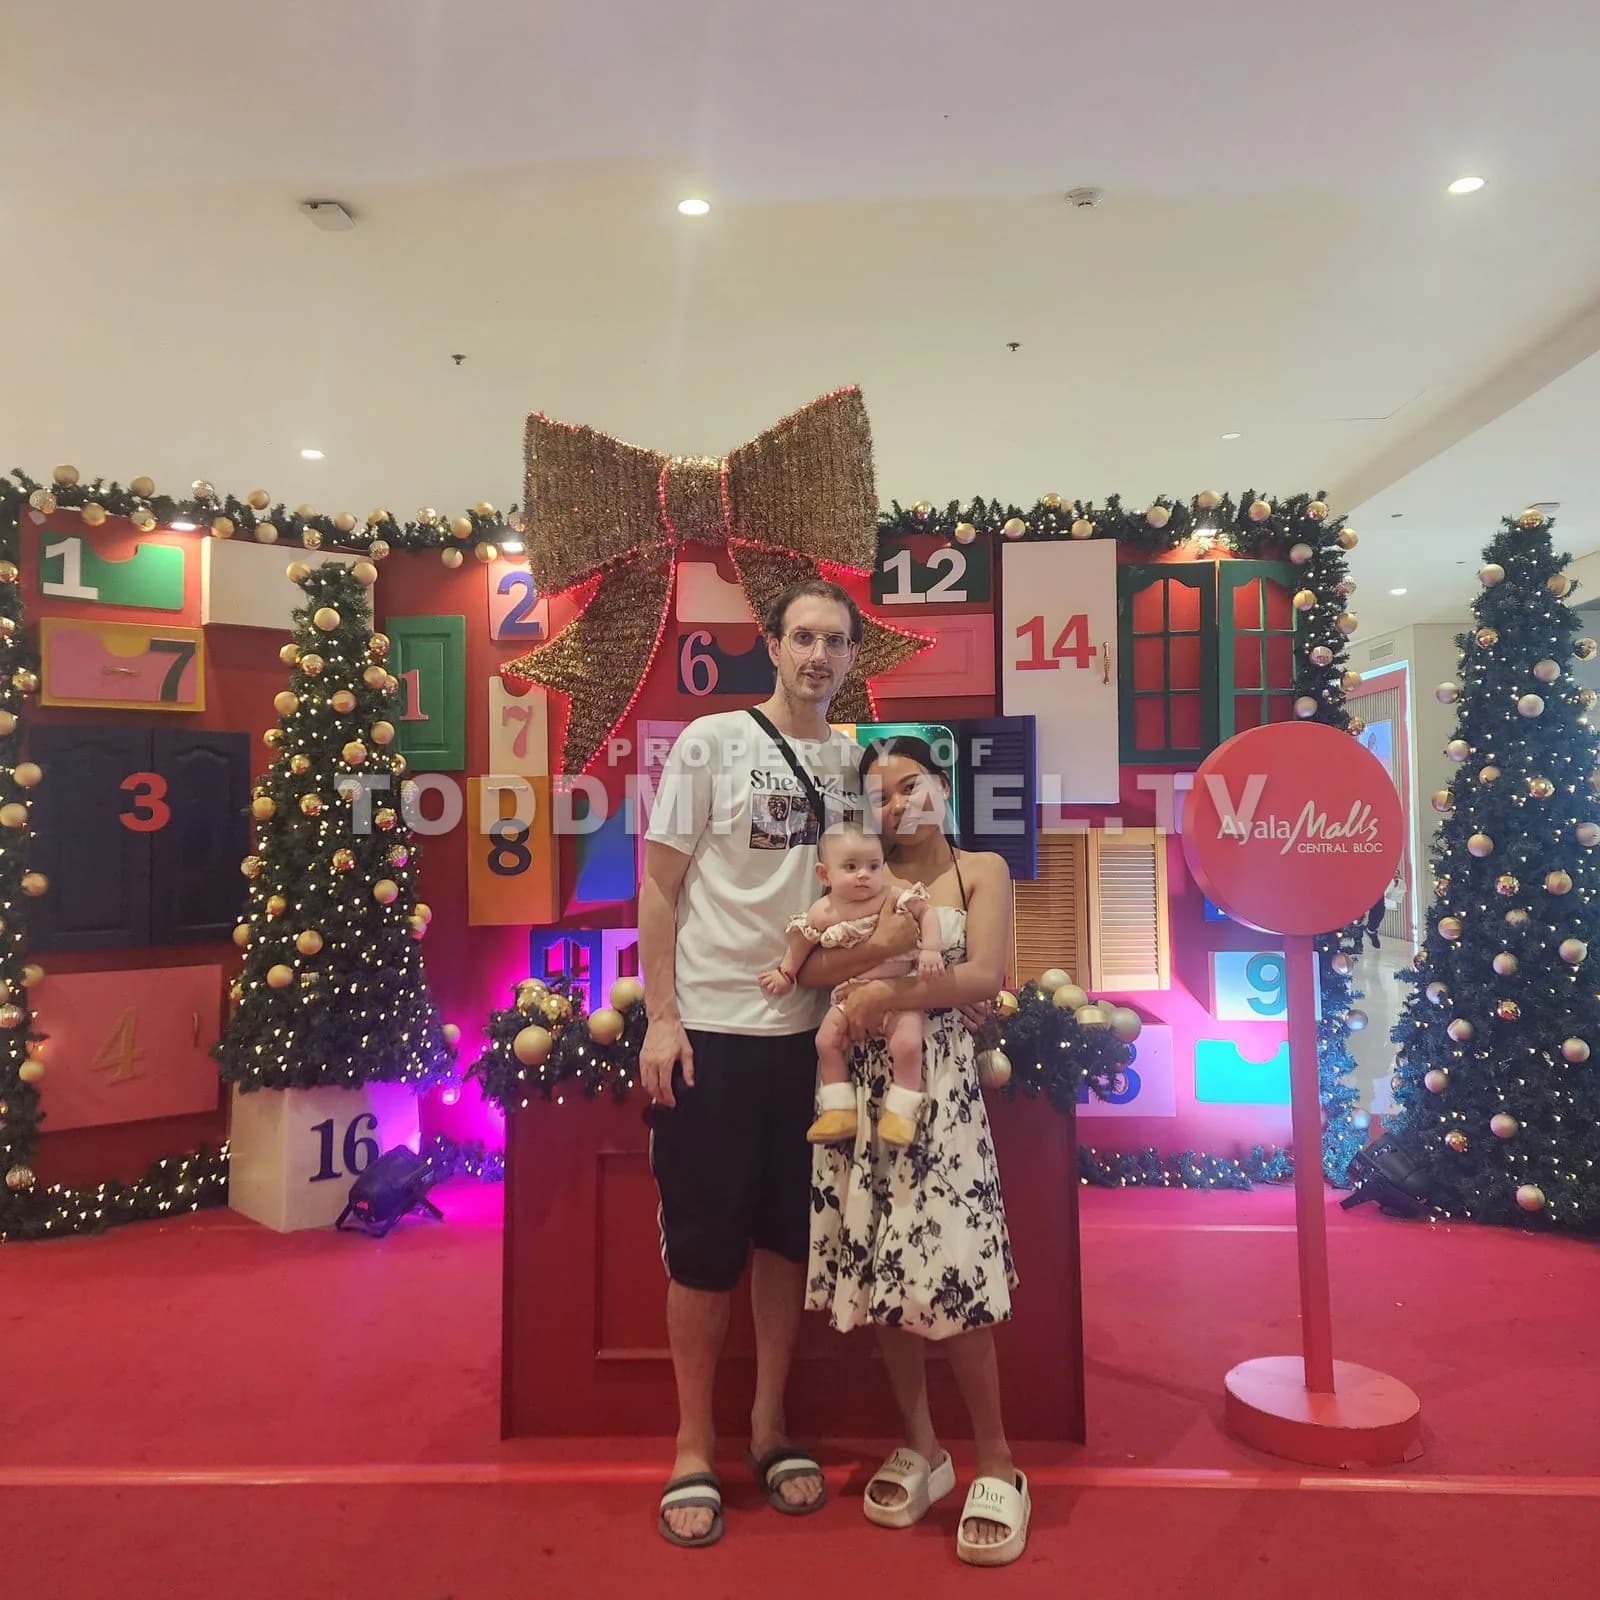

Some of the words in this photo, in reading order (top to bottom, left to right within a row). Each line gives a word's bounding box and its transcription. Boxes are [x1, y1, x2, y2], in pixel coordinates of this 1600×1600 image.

[42, 536, 99, 600] 1
[881, 548, 968, 605] 12
[496, 571, 541, 635] 2
[149, 638, 197, 702] 7
[680, 629, 720, 697] 6
[1015, 614, 1097, 671] 14
[502, 705, 534, 759] 7
[118, 772, 172, 832] 3
[1216, 814, 1292, 846] Ayala
[1279, 799, 1379, 856] Malls
[487, 817, 533, 876] 8
[1297, 842, 1348, 853] CENTRAL
[1353, 842, 1383, 853] BLOC
[1246, 952, 1287, 1016] 9
[95, 1005, 147, 1087] 4
[309, 1112, 381, 1184] 16
[972, 1482, 1005, 1505] Dior
